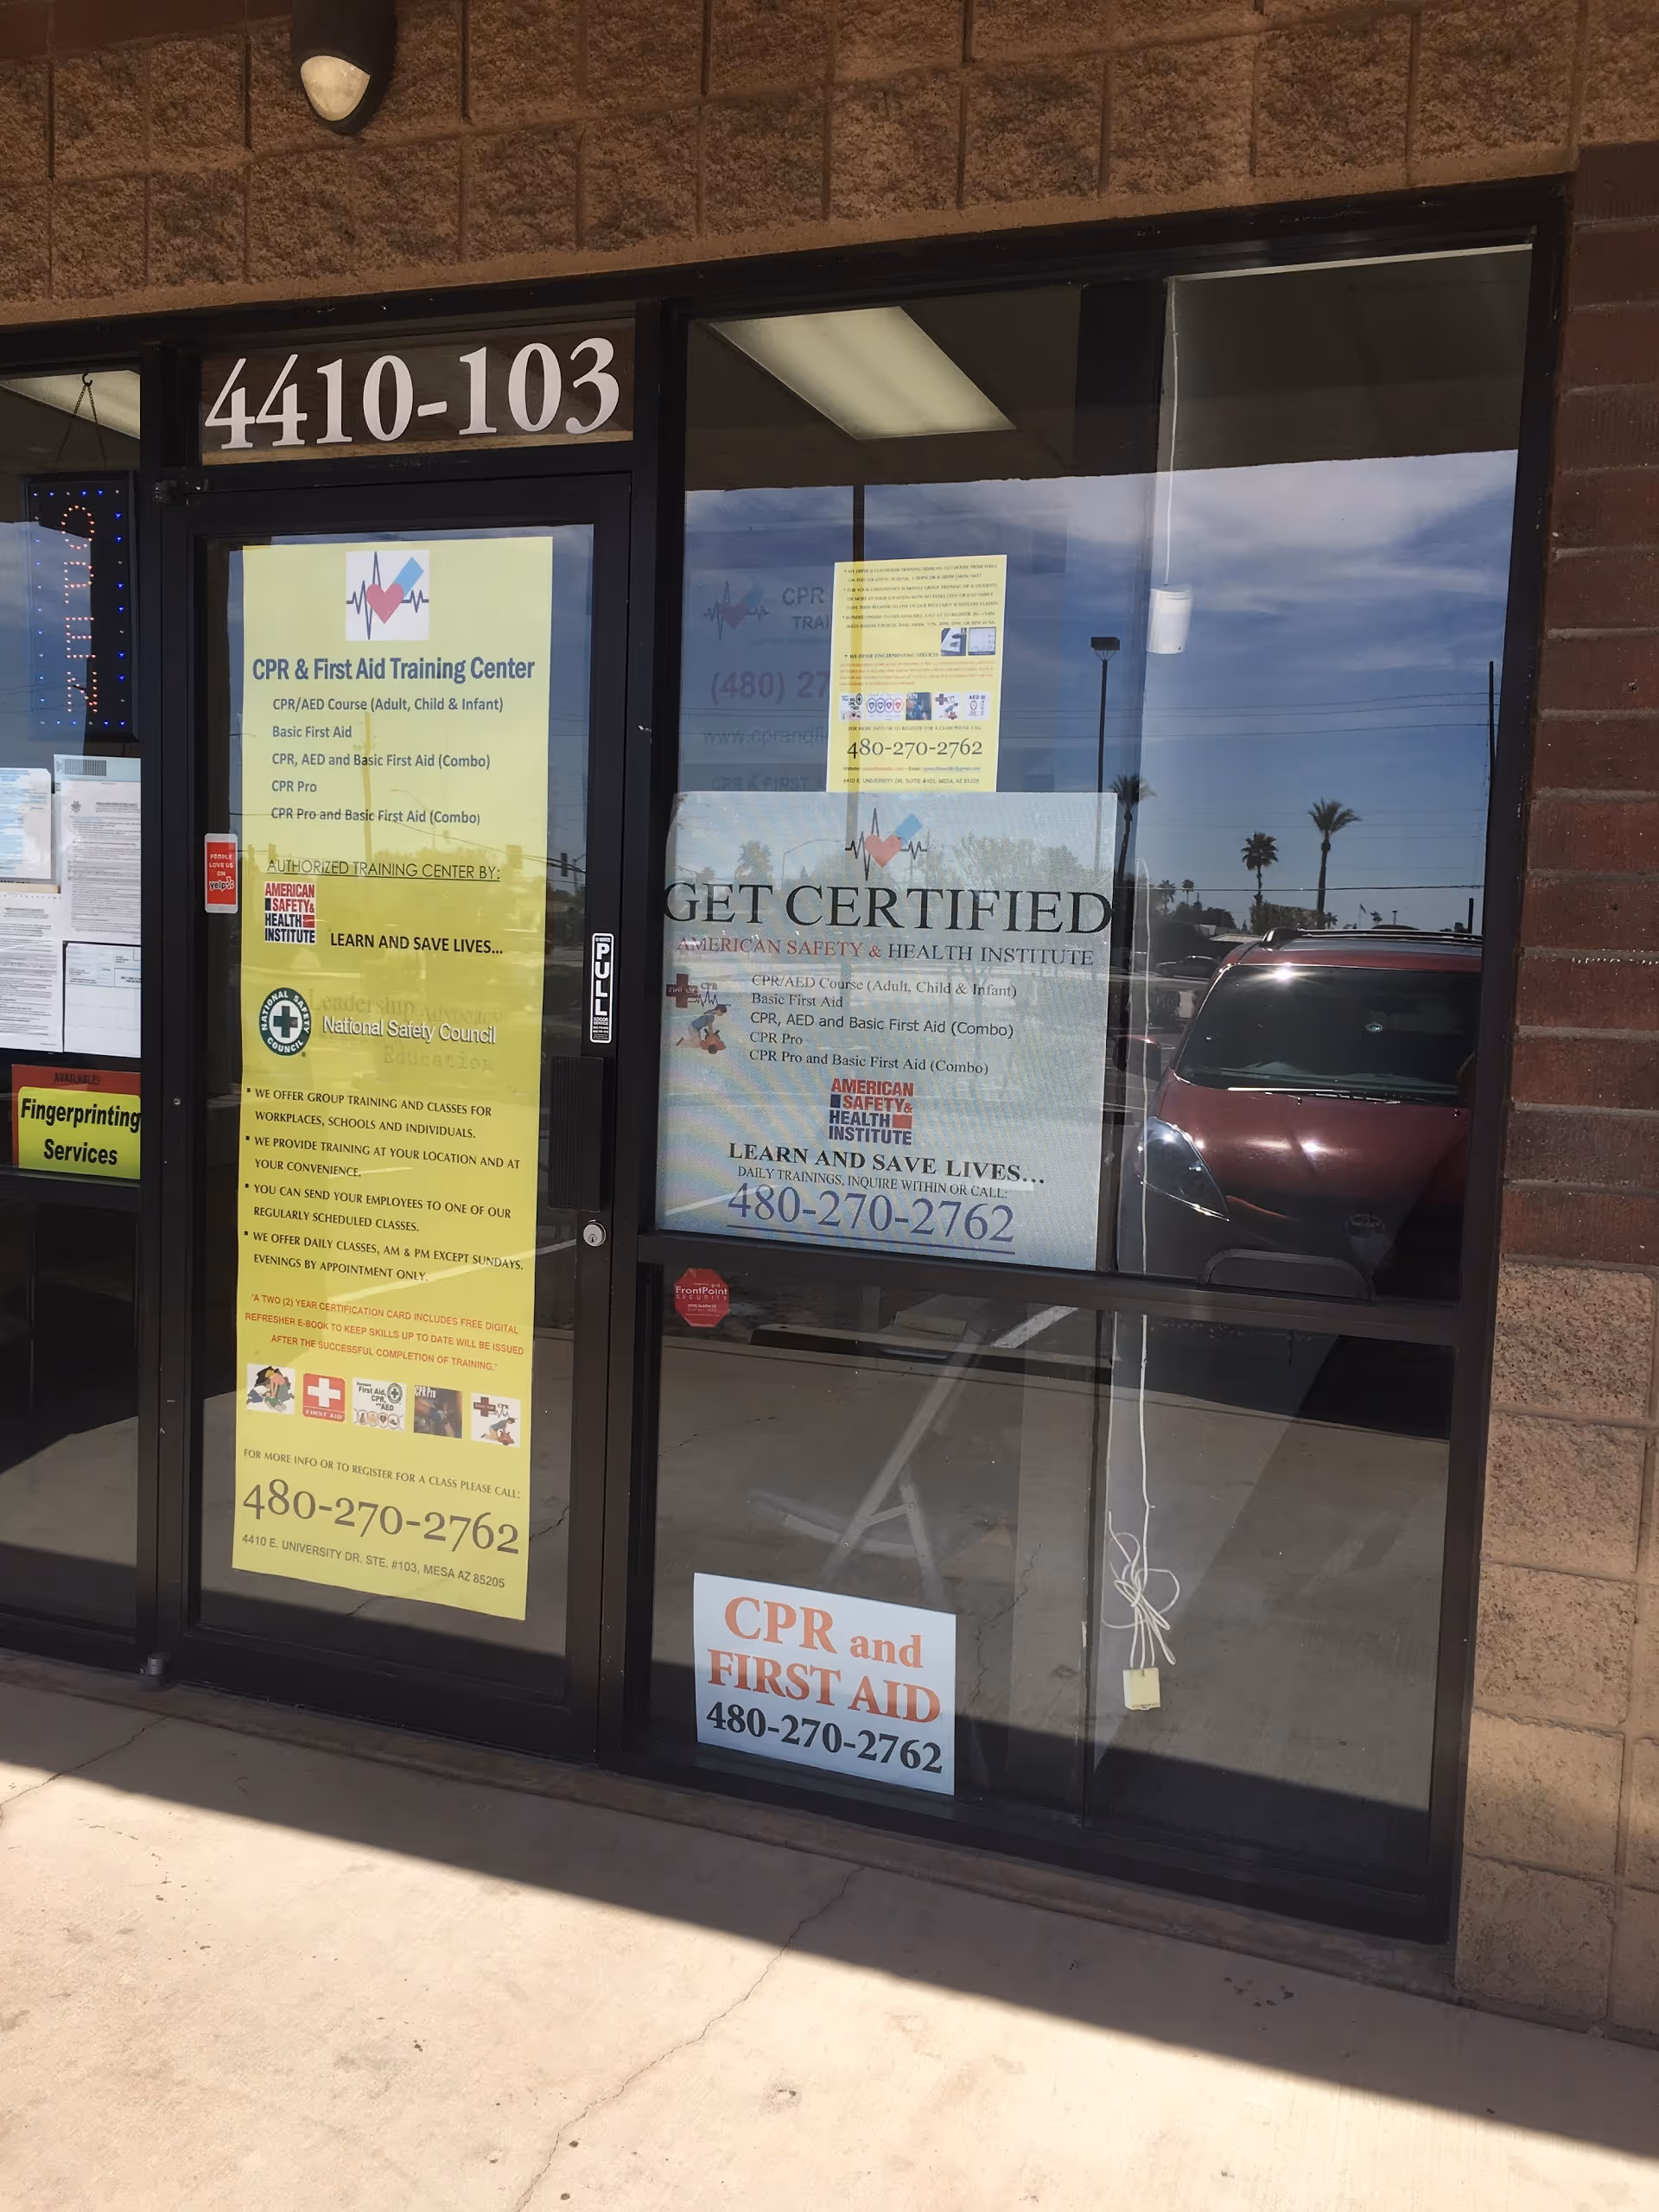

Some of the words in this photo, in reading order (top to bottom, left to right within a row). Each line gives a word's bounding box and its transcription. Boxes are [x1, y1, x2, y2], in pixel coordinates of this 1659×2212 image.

[204, 337, 620, 450] 4410-103
[60, 504, 99, 713] OPEN
[782, 587, 824, 606] CPR
[252, 658, 289, 680] CPR
[294, 658, 309, 680] &
[314, 658, 353, 680] First
[354, 657, 385, 680] Aid
[389, 657, 467, 684] Training
[469, 656, 536, 679] Center
[710, 671, 786, 706] (480)
[272, 696, 325, 712] CPR/AED
[327, 697, 367, 710] Course
[370, 696, 411, 713] (Adult,
[413, 696, 445, 710] Child
[448, 696, 459, 710] &
[461, 696, 504, 713] Infant)
[271, 725, 302, 738] Basic
[304, 725, 330, 738] First
[332, 725, 353, 738] Aid
[847, 737, 983, 760] 480-270-2762
[270, 779, 295, 792] CPR
[297, 780, 317, 792] Pro
[267, 860, 349, 874] AUTHORIZED
[353, 861, 417, 877] TRAINING
[421, 864, 474, 879] CENTER
[479, 866, 499, 880] BY:
[264, 882, 315, 898] AMERICAN
[264, 913, 302, 928] HEALTH
[664, 881, 773, 924] GET
[785, 884, 1115, 935] CERTIFIED
[264, 928, 315, 944] INSTITUTE
[330, 932, 375, 948] LEARN
[378, 935, 410, 950] AND
[413, 936, 449, 952] SAVE
[453, 938, 503, 954] LIVES...
[676, 934, 781, 956] AMERICAN
[786, 939, 863, 957] SAFETY
[868, 943, 882, 958] &
[887, 943, 973, 961] HEALTH
[980, 946, 1094, 969] INSTITUTE
[594, 942, 610, 1016] PULL
[751, 974, 816, 990] CPR/AED
[820, 976, 864, 991] Course
[867, 978, 912, 995] (Adult,
[915, 980, 951, 995] Child
[955, 982, 968, 996] &
[972, 982, 1017, 999] Infant)
[261, 990, 289, 1031] NATIONAL
[294, 995, 310, 1033] SAFETY
[751, 992, 785, 1005] Basic
[788, 994, 817, 1007] First
[819, 995, 843, 1007] Aid
[323, 1015, 385, 1037] National
[386, 1020, 436, 1044] Safety
[439, 1023, 497, 1045] Council
[748, 1031, 778, 1044] CPR
[781, 1033, 803, 1045] Pro
[749, 1011, 781, 1027] CPR,
[785, 1013, 815, 1027] AED
[817, 1015, 844, 1028] and
[849, 1015, 885, 1030] Basic
[888, 1017, 919, 1032] First
[923, 1020, 946, 1033] Aid
[950, 1020, 1014, 1039] (Combo)
[267, 1037, 303, 1052] COUNCIL
[748, 1049, 778, 1062] CPR
[781, 1050, 803, 1063] Pro
[805, 1052, 828, 1065] and
[831, 1053, 867, 1067] Basic
[869, 1055, 899, 1069] First
[902, 1058, 926, 1071] Aid
[930, 1059, 988, 1075] (Combo)
[830, 1077, 914, 1096] AMERICAN
[21, 1097, 140, 1134] Fingerprinting
[254, 1088, 270, 1099] WE
[272, 1090, 304, 1101] OFFER
[307, 1092, 345, 1104] GROUP
[346, 1095, 397, 1109] TRAINING
[400, 1099, 424, 1110] AND
[426, 1102, 467, 1115] CLASSES
[470, 1104, 492, 1116] FOR
[830, 1110, 891, 1128] HEALTH
[829, 1125, 912, 1146] INSTITUTE
[43, 1138, 118, 1166] Services
[728, 1142, 809, 1164] LEARN
[813, 1150, 866, 1168] AND
[872, 1154, 937, 1174] SAVE
[945, 1160, 1045, 1184] LIVES...
[737, 1165, 774, 1179] DAILY
[776, 1169, 845, 1185] TRAININGS,
[847, 1175, 898, 1190] INQUIRE
[899, 1179, 947, 1193] WITHIN
[949, 1183, 968, 1196] OR
[969, 1185, 1007, 1198] CALL:
[727, 1181, 1015, 1243] 480-270-2762
[675, 1286, 728, 1295] FrontPoint
[270, 1334, 299, 1345] AFTER
[299, 1338, 317, 1348] THE
[317, 1340, 373, 1356] SUCCESSFUL
[375, 1348, 435, 1363] COMPLETION
[435, 1355, 449, 1364] OF
[415, 1385, 426, 1396] CPR
[426, 1388, 436, 1399] Pro
[306, 1409, 327, 1418] FIRST
[243, 1478, 519, 1554] 480-270-2762
[241, 1534, 267, 1547] 4410
[269, 1537, 278, 1548] E.
[282, 1540, 342, 1559] UNIVERSITY
[344, 1550, 363, 1563] DR.
[365, 1554, 389, 1568] STE.
[391, 1560, 420, 1575] #103,
[423, 1564, 455, 1581] MESA
[456, 1569, 472, 1582] AZ
[472, 1573, 505, 1588] 85205
[724, 1596, 838, 1655] CPR
[849, 1634, 925, 1669] and
[707, 1648, 842, 1707] FIRST
[847, 1675, 942, 1724] AID
[705, 1701, 944, 1774] 480-270-2762
